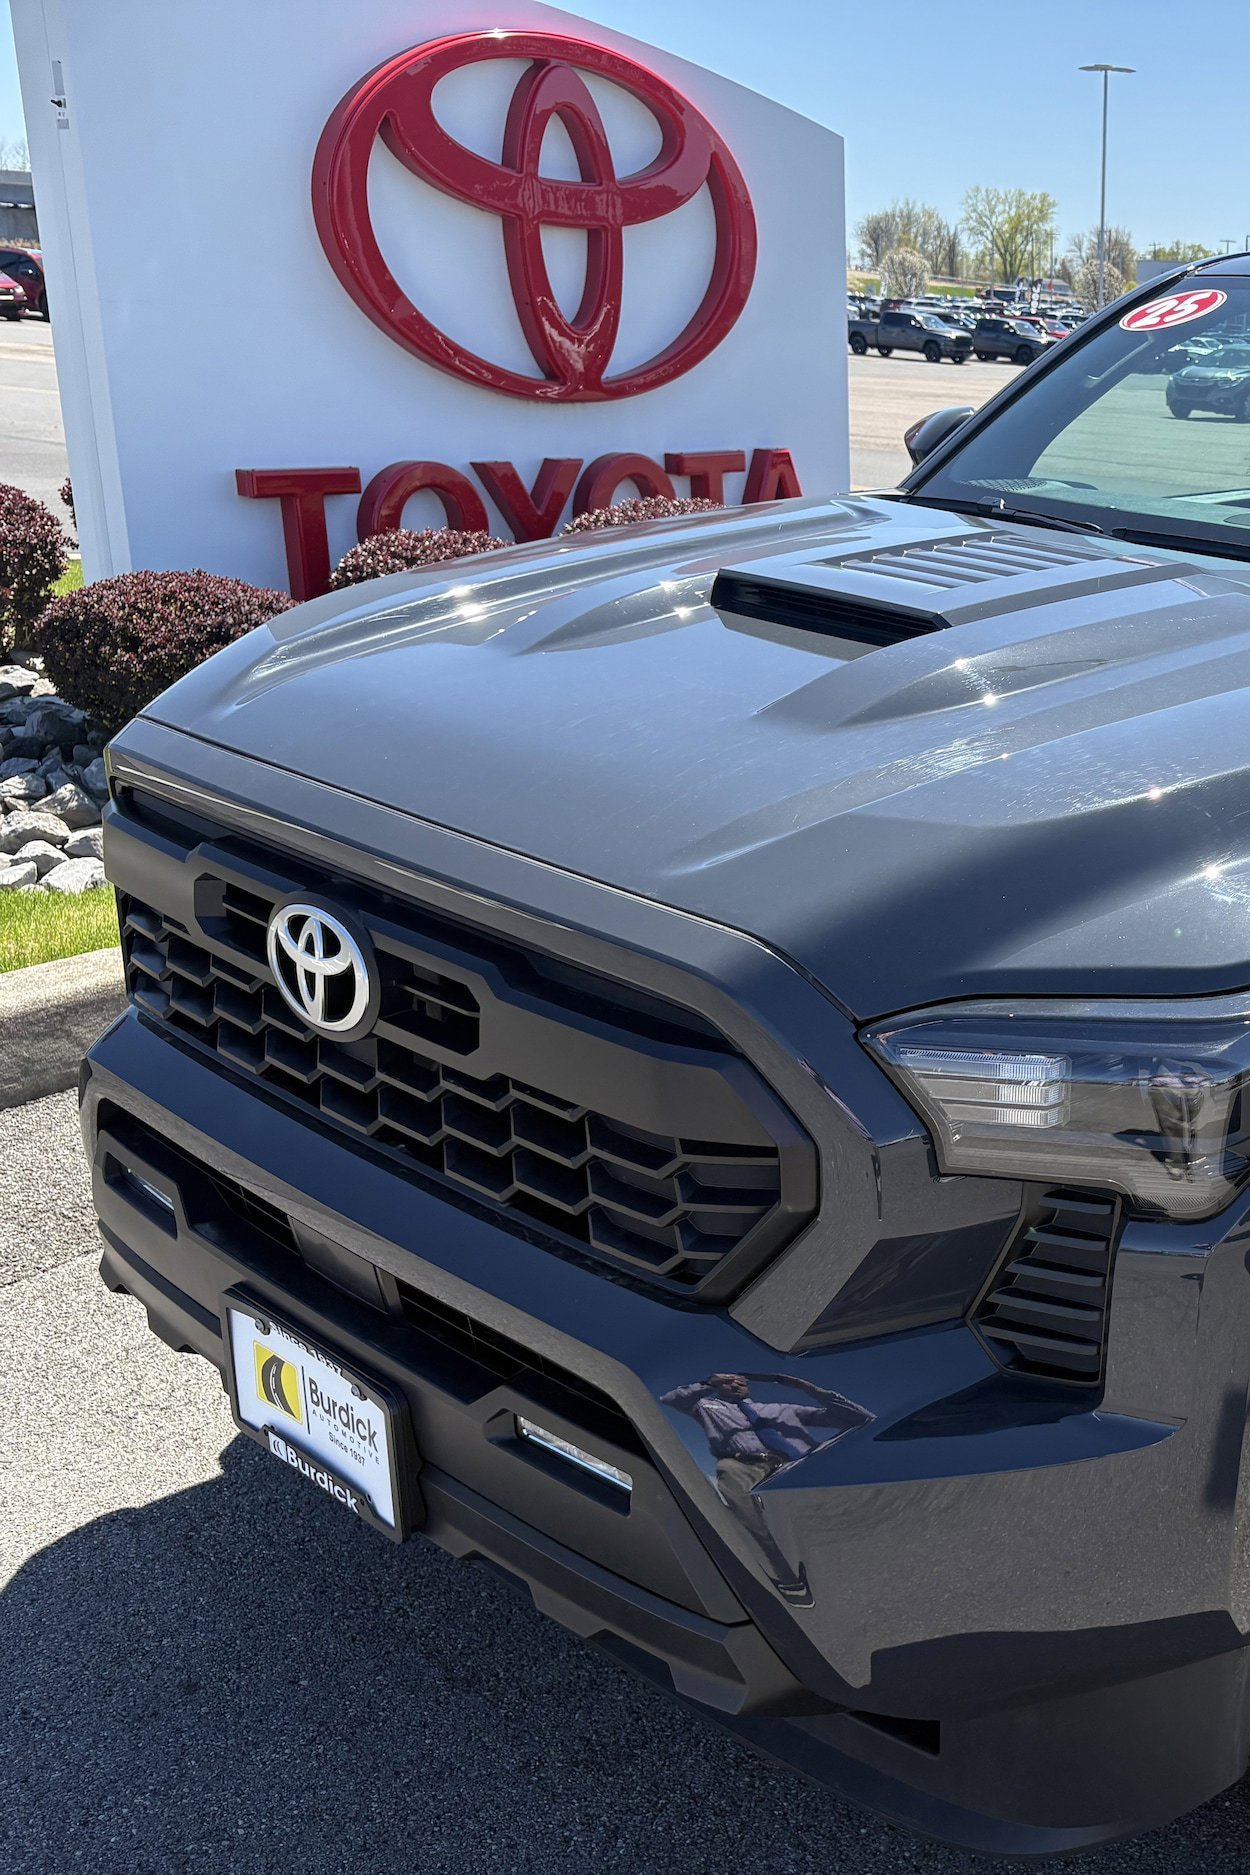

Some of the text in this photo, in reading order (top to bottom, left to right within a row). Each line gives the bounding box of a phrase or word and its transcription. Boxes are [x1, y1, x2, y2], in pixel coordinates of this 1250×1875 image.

[1130, 291, 1213, 328] 25
[308, 1376, 379, 1453] Burdick
[312, 1409, 380, 1465] AUTOMOTIVE
[328, 1431, 366, 1467] Since 1937
[286, 1445, 359, 1514] Burdick
